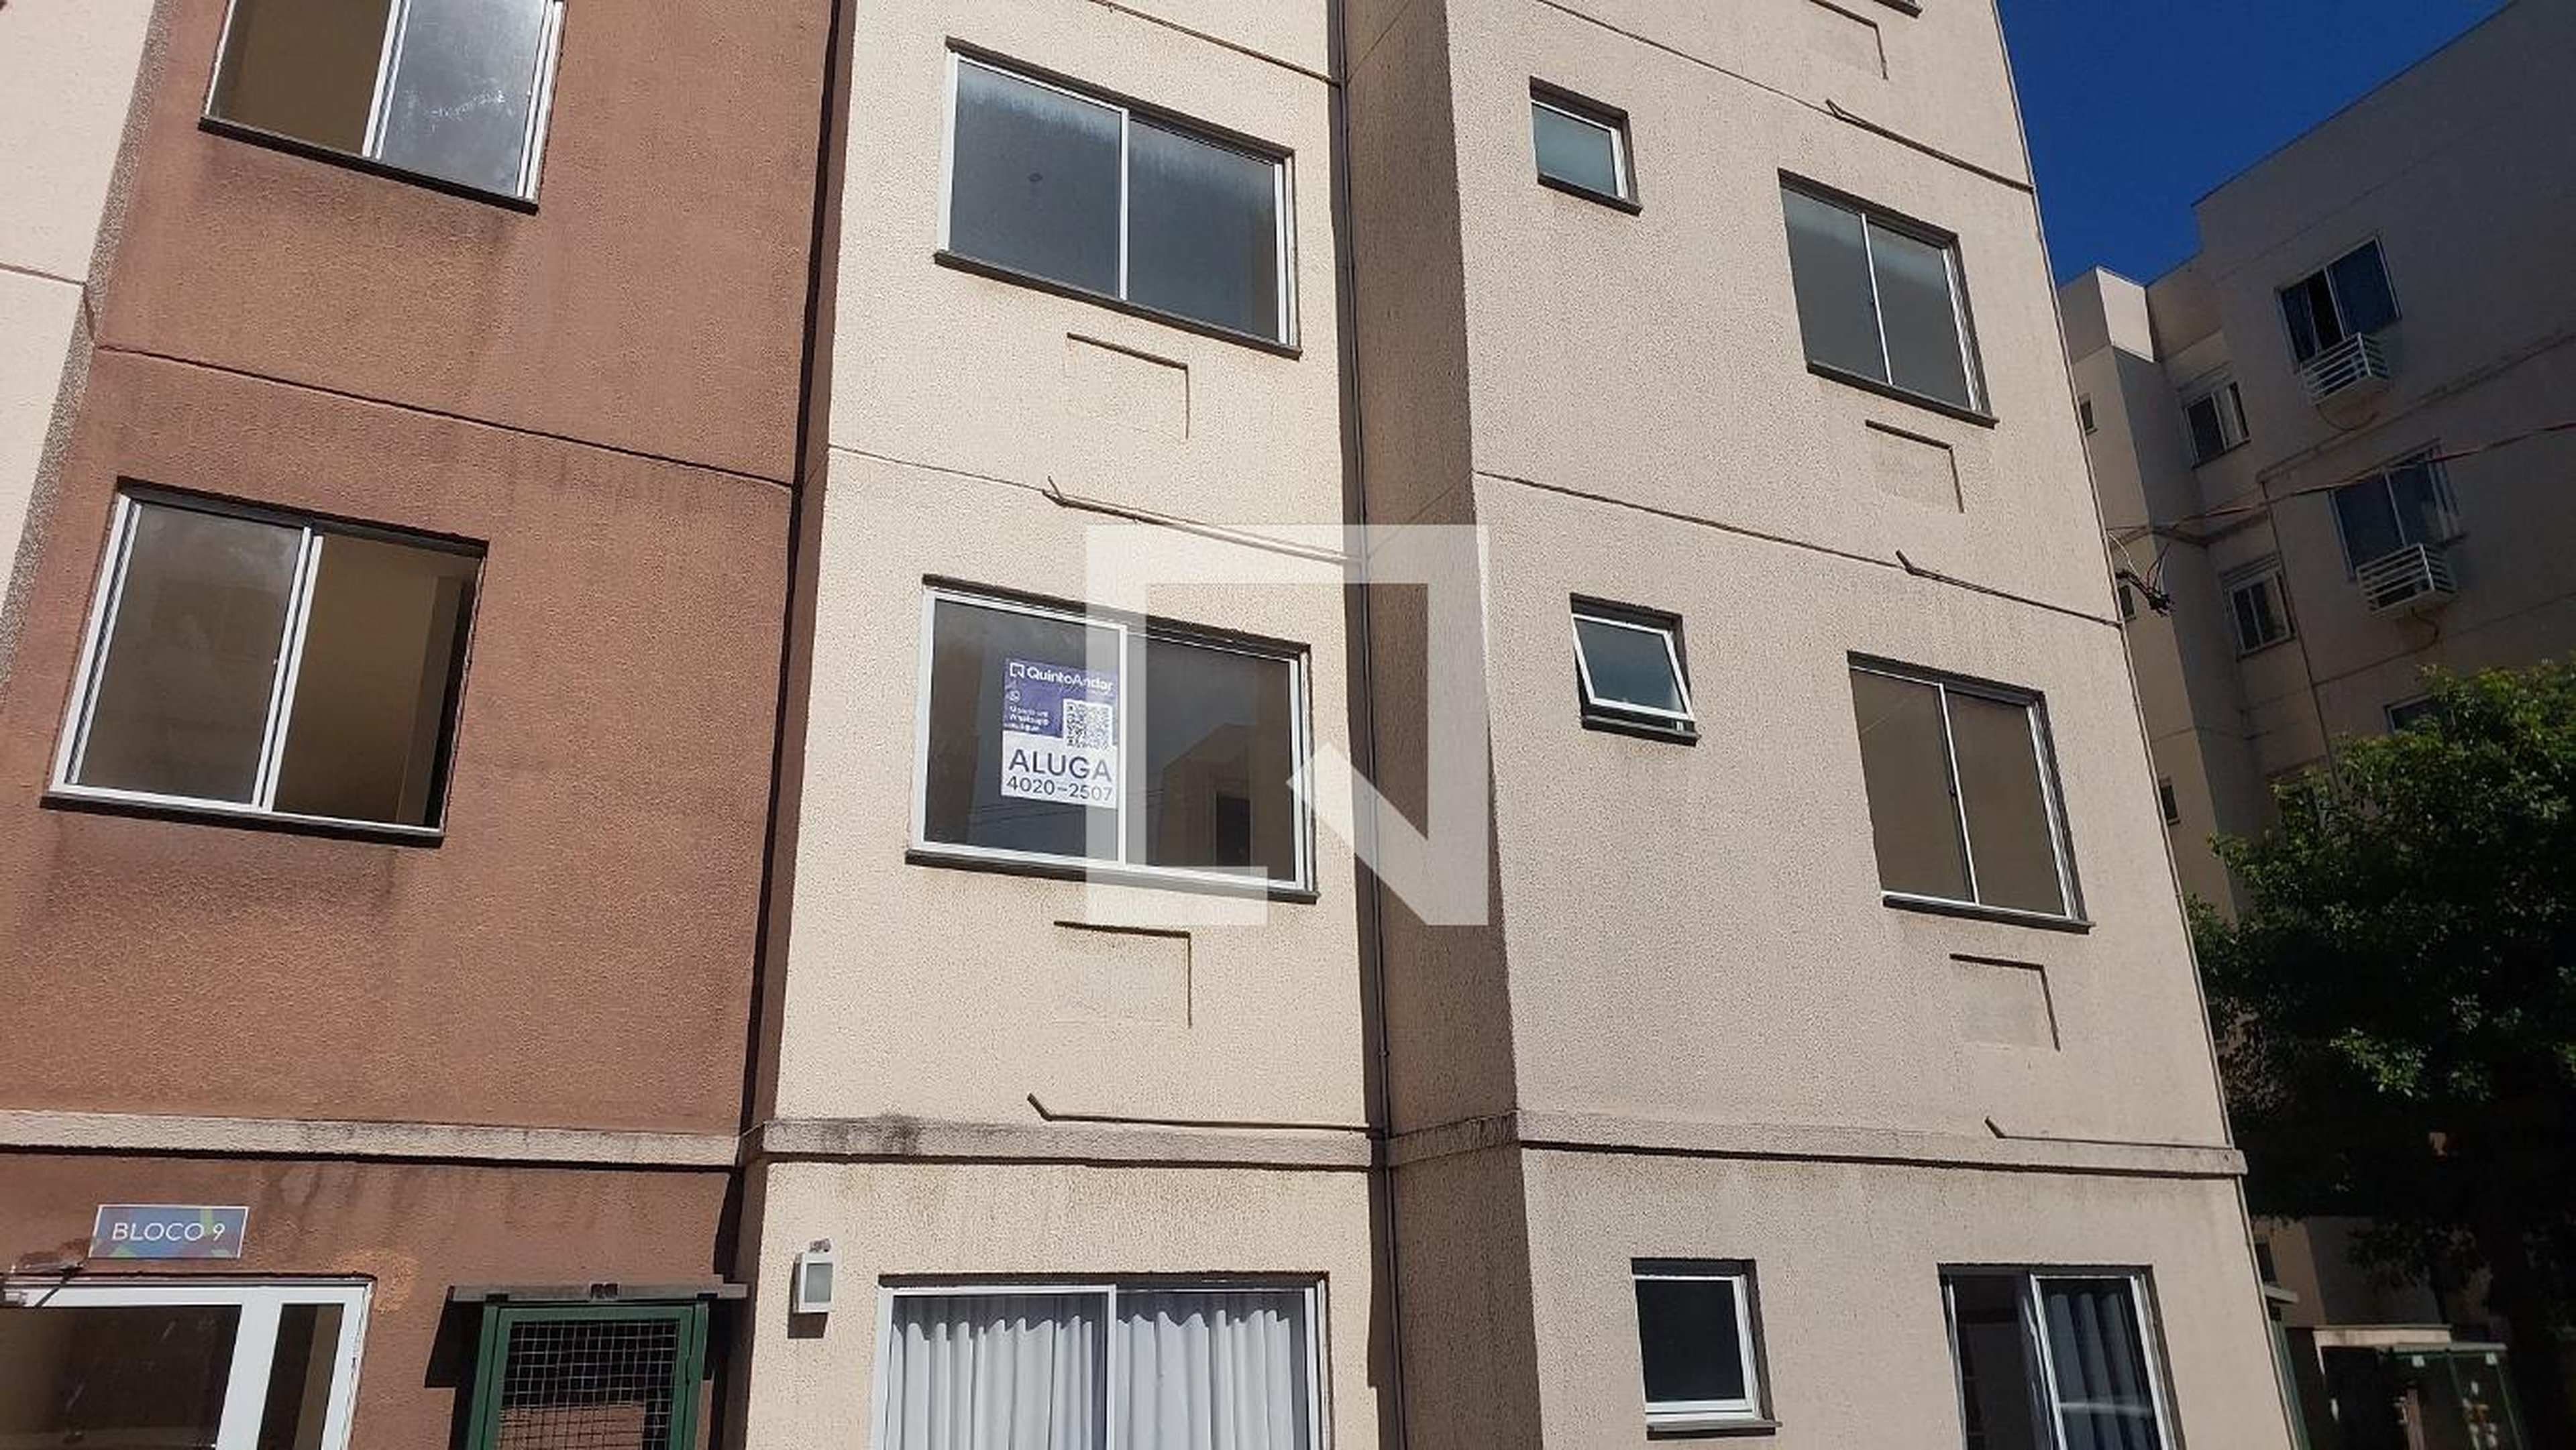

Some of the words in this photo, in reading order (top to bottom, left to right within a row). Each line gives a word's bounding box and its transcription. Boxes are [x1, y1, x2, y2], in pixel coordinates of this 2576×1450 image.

[1026, 666, 1114, 691] QuintoAndar
[1008, 748, 1112, 782] ALUGA
[1006, 775, 1113, 801] 4020-2507
[112, 1222, 205, 1241] BLOCO
[213, 1223, 225, 1241] 9
